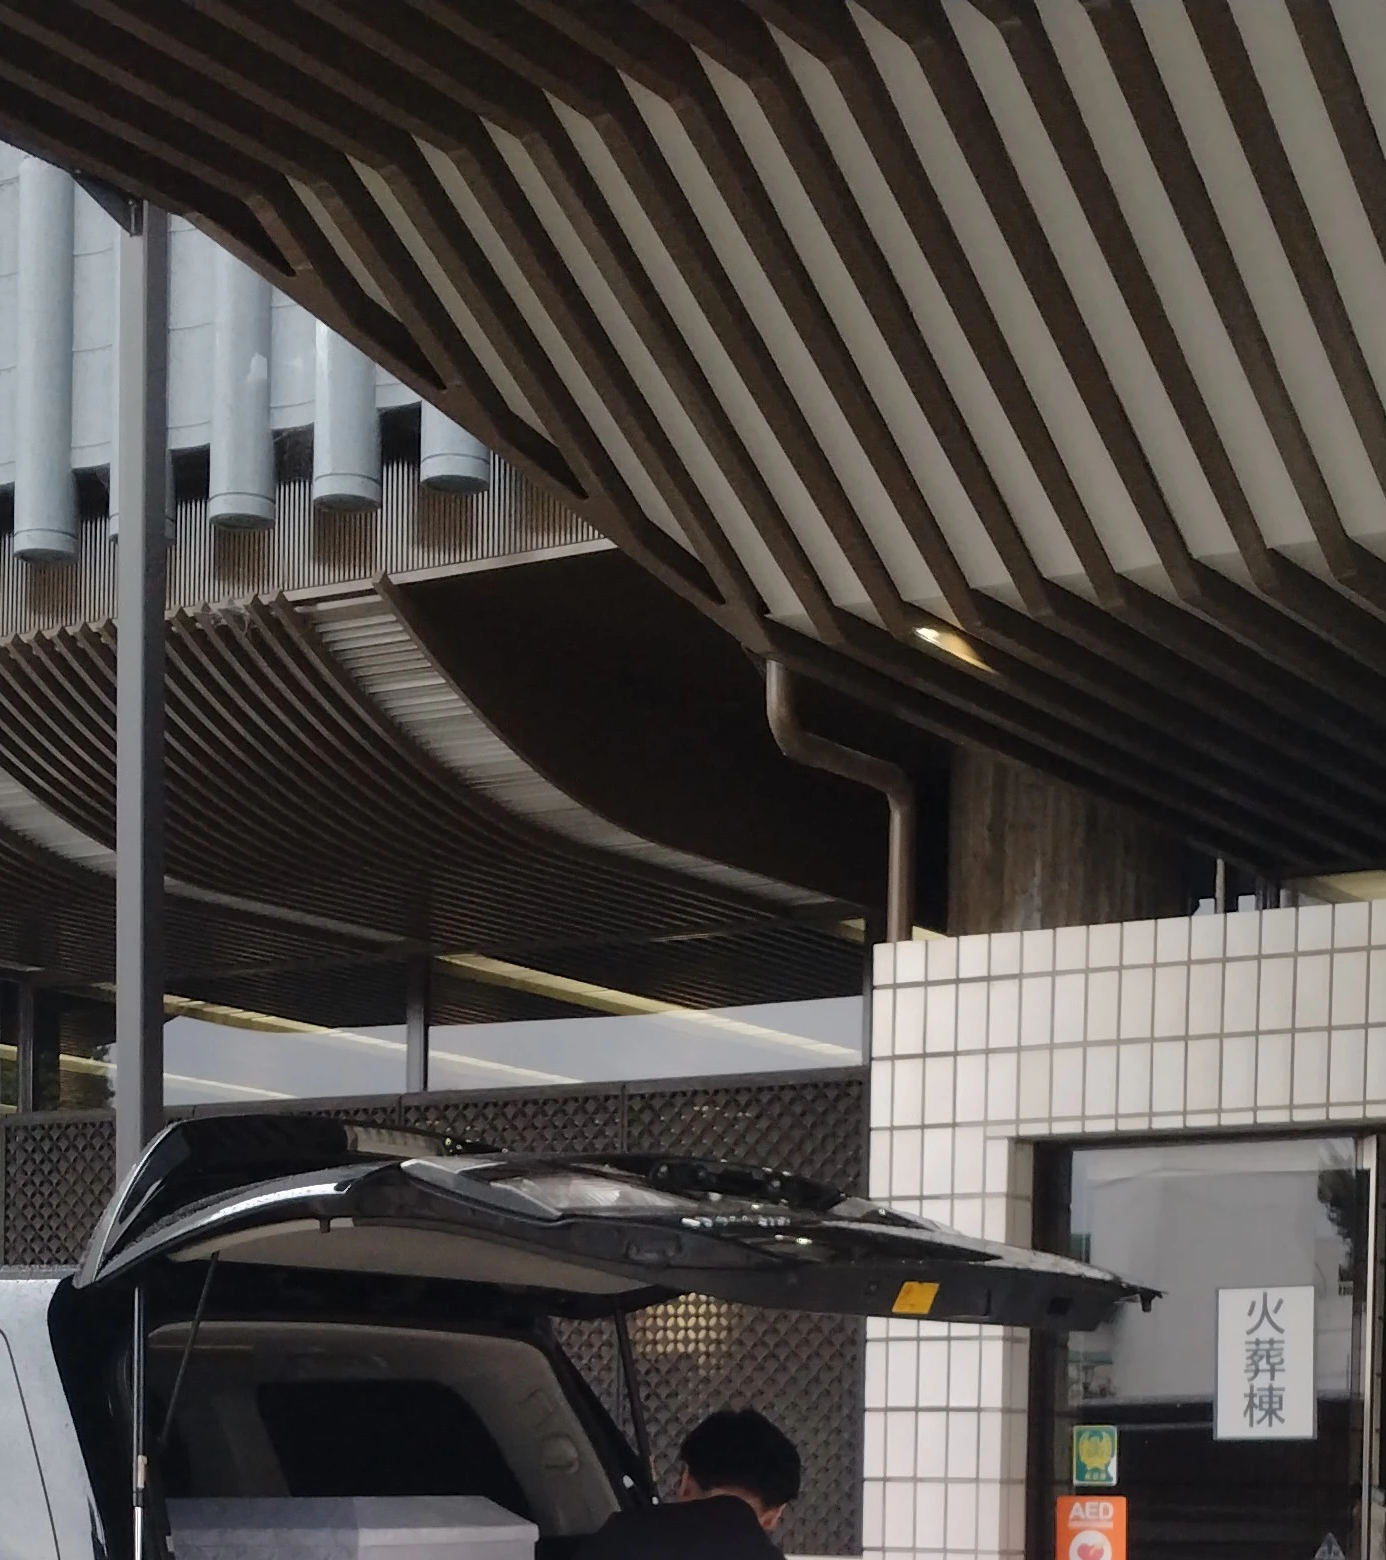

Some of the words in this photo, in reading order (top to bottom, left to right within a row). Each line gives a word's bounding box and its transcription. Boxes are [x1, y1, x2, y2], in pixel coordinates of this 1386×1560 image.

[1244, 1291, 1286, 1428] 火葬棟
[1068, 1501, 1114, 1520] AED
